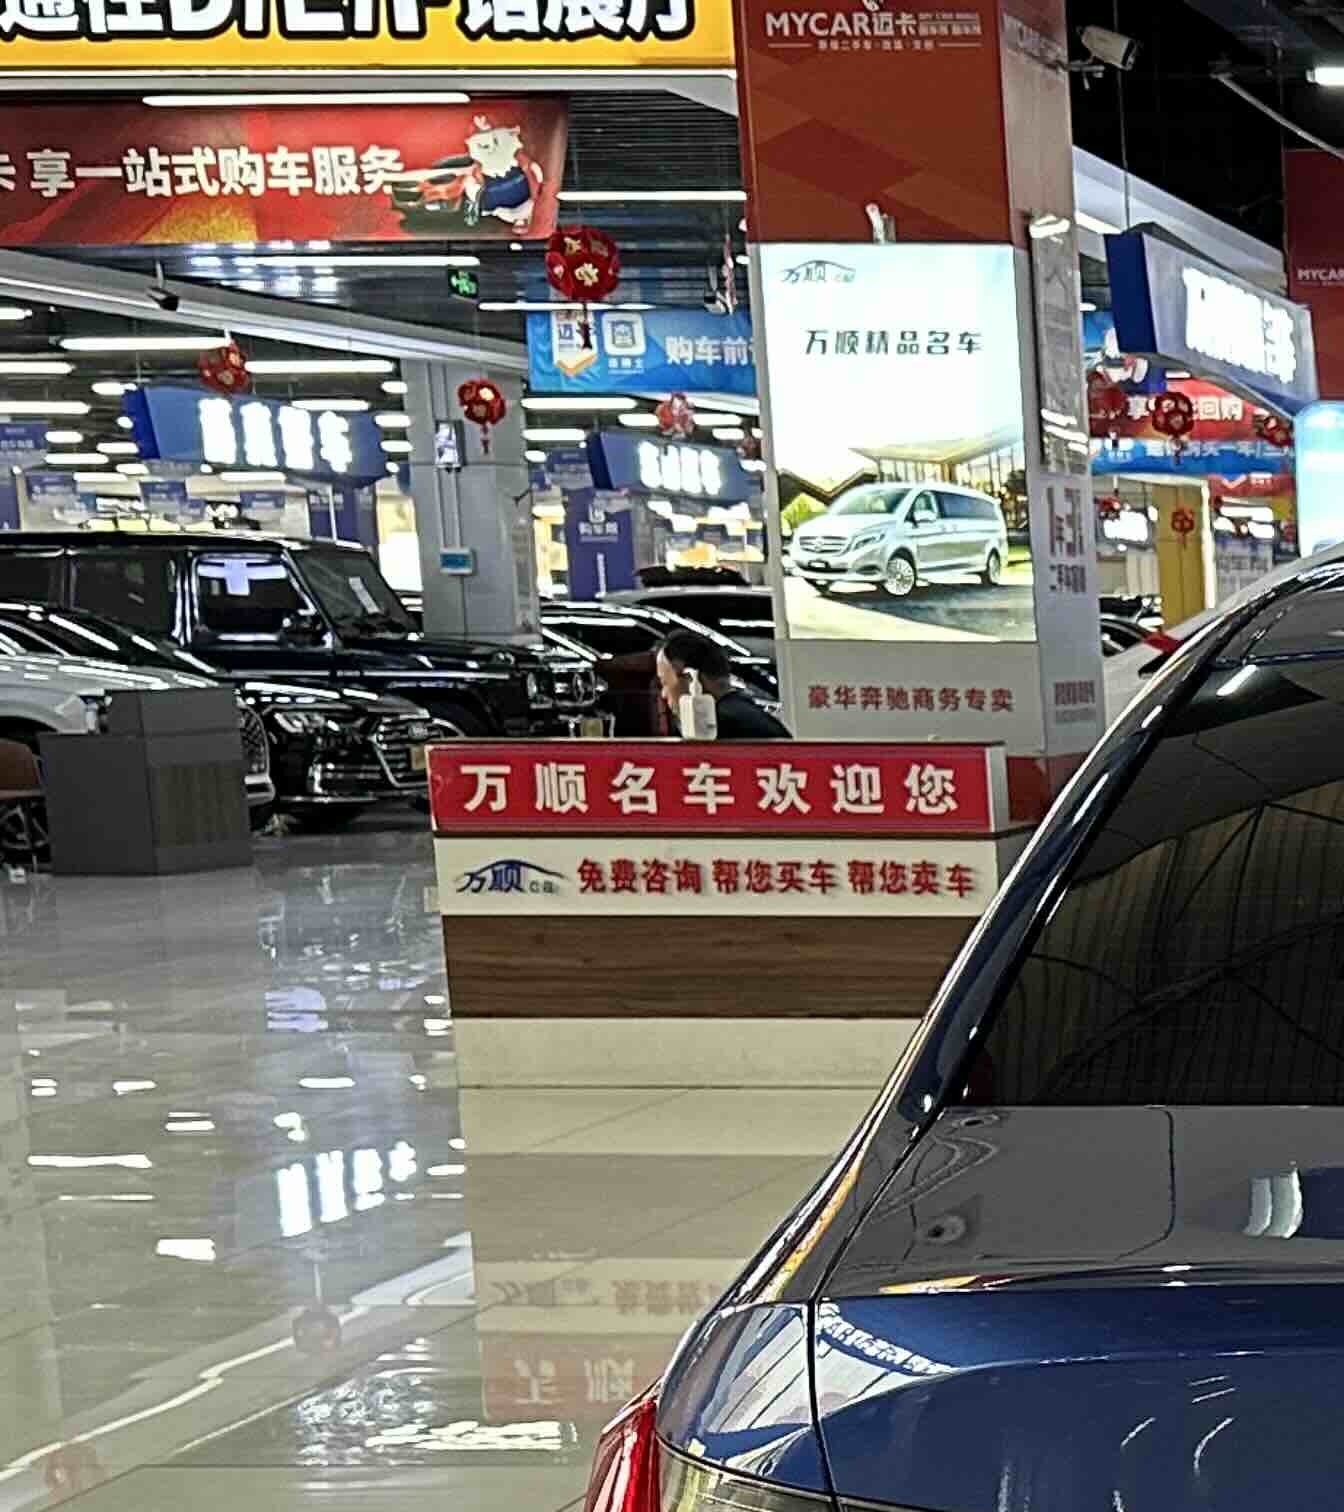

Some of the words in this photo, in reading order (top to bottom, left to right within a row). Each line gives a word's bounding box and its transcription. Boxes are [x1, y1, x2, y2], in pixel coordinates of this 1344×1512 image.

[27, 145, 403, 197] 享一站式购车服务
[664, 335, 754, 367] 购车前
[804, 329, 985, 356] 万顺精品名车
[808, 684, 1014, 713] 豪华奔驰商务专卖
[460, 761, 960, 815] 万顺名车欢迎您
[577, 857, 701, 896] 免费咨询
[711, 857, 839, 896] 帮您买车
[848, 858, 975, 898] 帮您卖车
